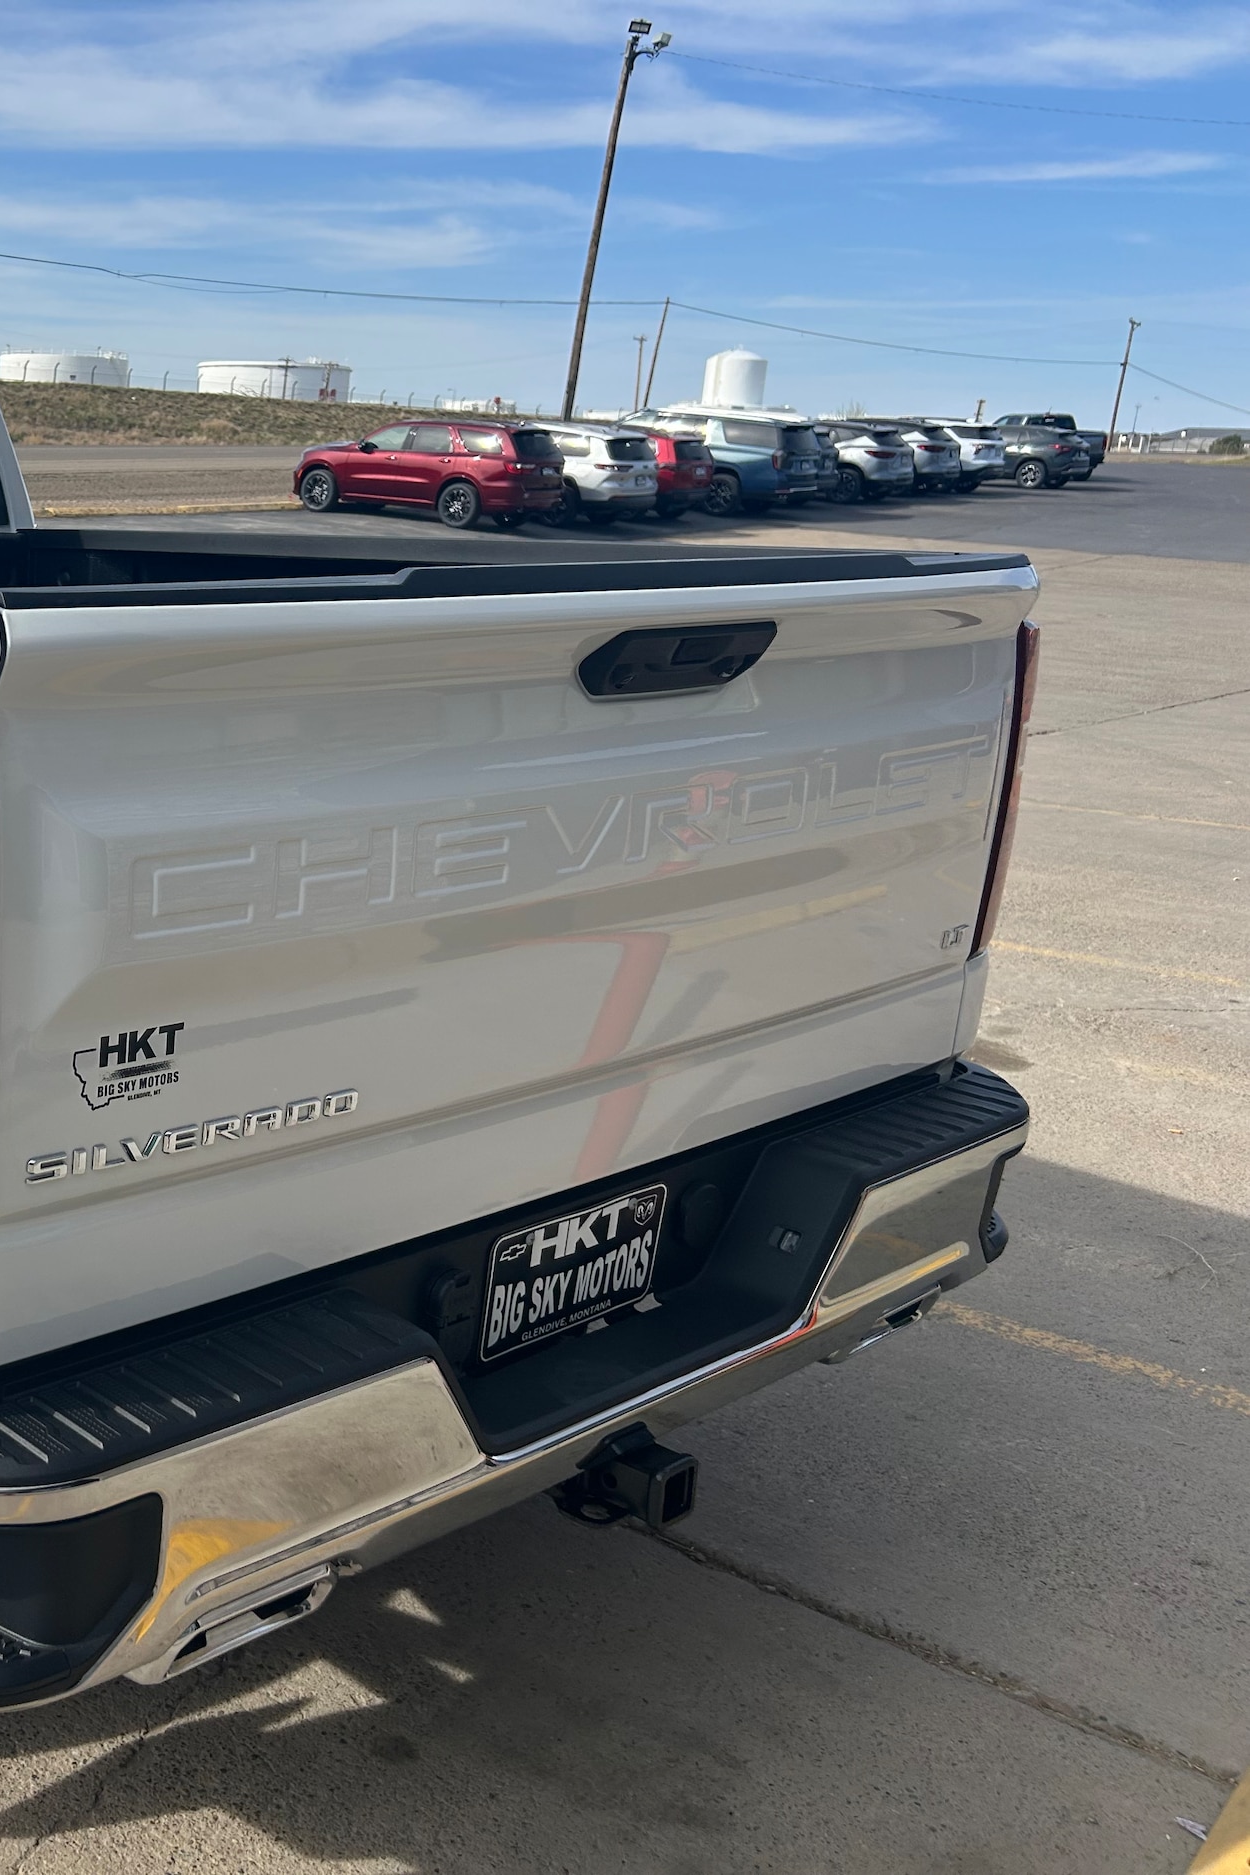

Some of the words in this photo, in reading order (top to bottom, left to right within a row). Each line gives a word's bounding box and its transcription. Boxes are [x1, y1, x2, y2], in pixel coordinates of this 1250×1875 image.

[128, 723, 989, 940] CHEVROLET
[940, 923, 969, 949] LT
[99, 1021, 185, 1068] HKT
[97, 1083, 115, 1098] BIG
[117, 1079, 137, 1094] SKY
[139, 1071, 179, 1090] MOTORS
[25, 1087, 360, 1185] SILVERADO
[529, 1198, 630, 1268] HKT
[487, 1281, 527, 1348] BIG
[528, 1269, 573, 1324] SKY
[572, 1229, 653, 1305] MOTORS
[521, 1317, 568, 1342] GLENDIVE,
[569, 1299, 612, 1323] MONTANA
